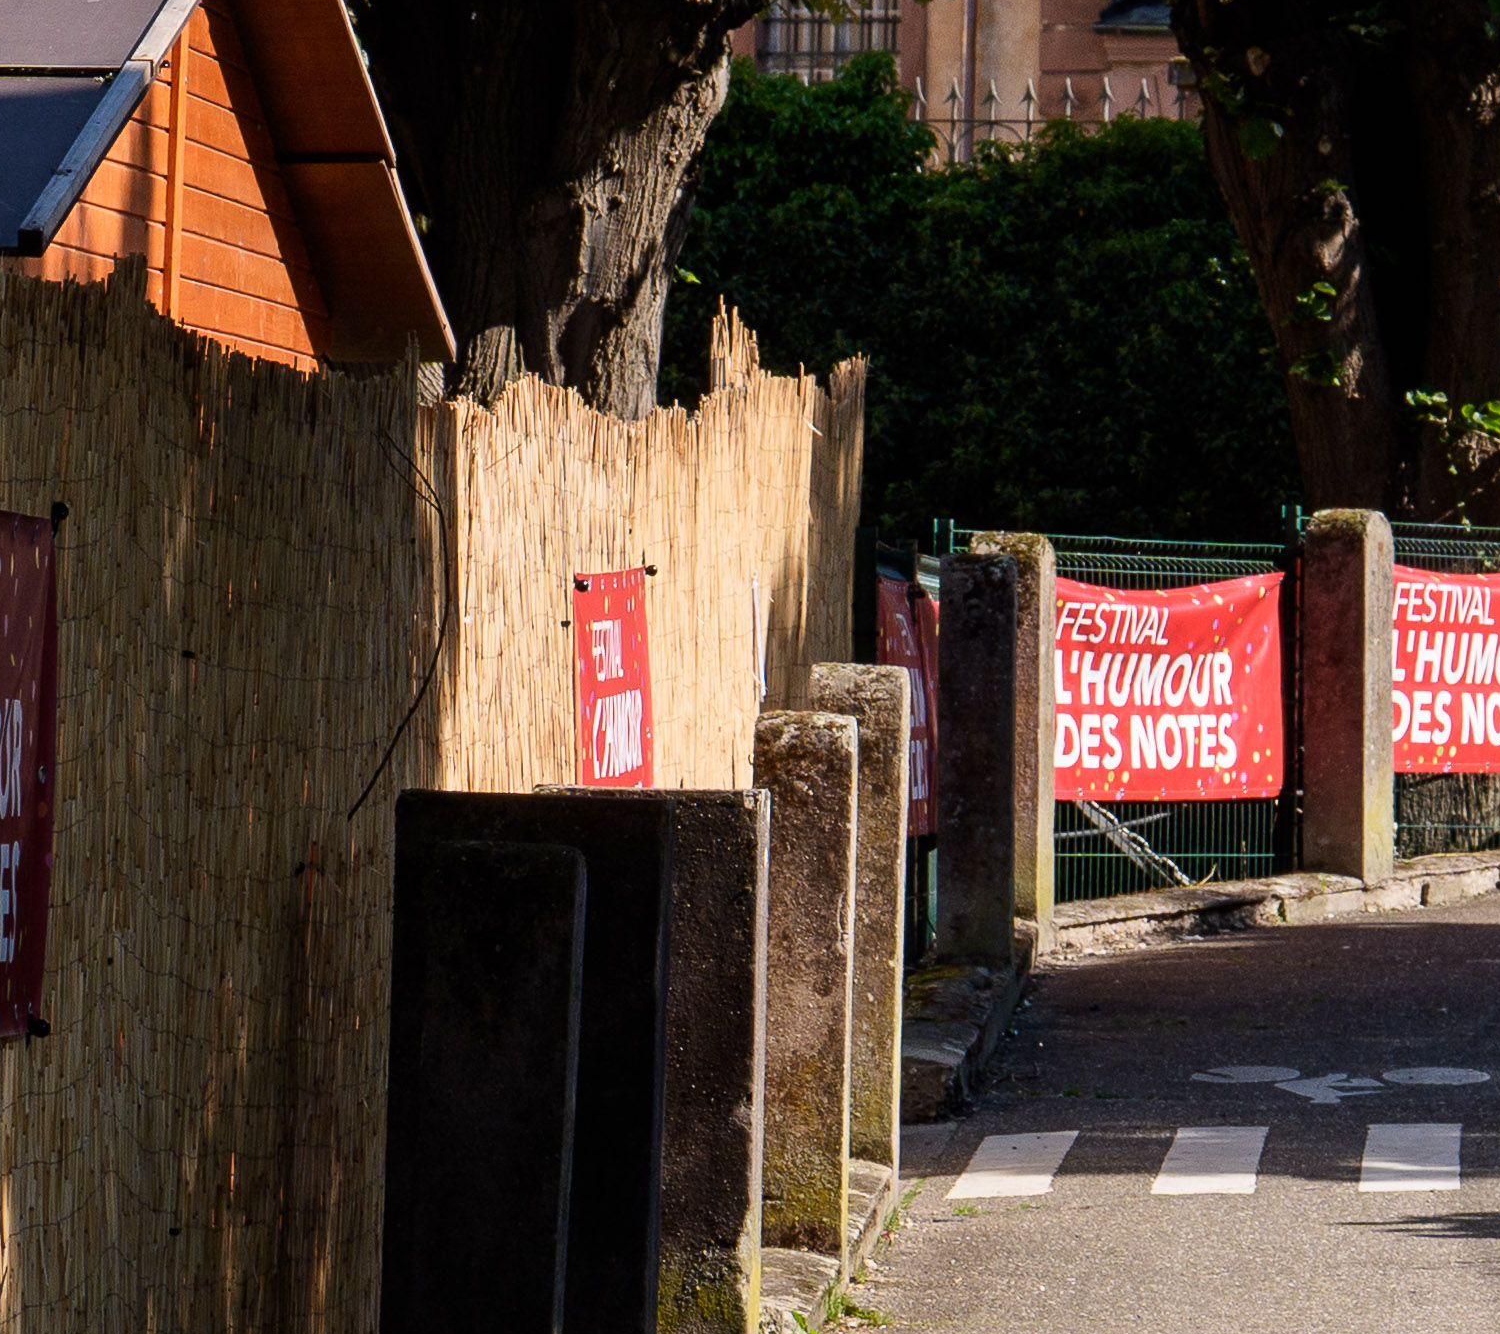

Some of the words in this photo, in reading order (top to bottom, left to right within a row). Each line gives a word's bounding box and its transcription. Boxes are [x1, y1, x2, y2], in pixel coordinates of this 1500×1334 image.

[1055, 601, 1169, 645] FESTIVAL
[1393, 582, 1494, 625] FESTIVAL
[1054, 649, 1233, 707] L'HUMOUR
[1053, 713, 1122, 770] DES
[1130, 713, 1237, 770] NOTES
[1392, 690, 1452, 745] DES
